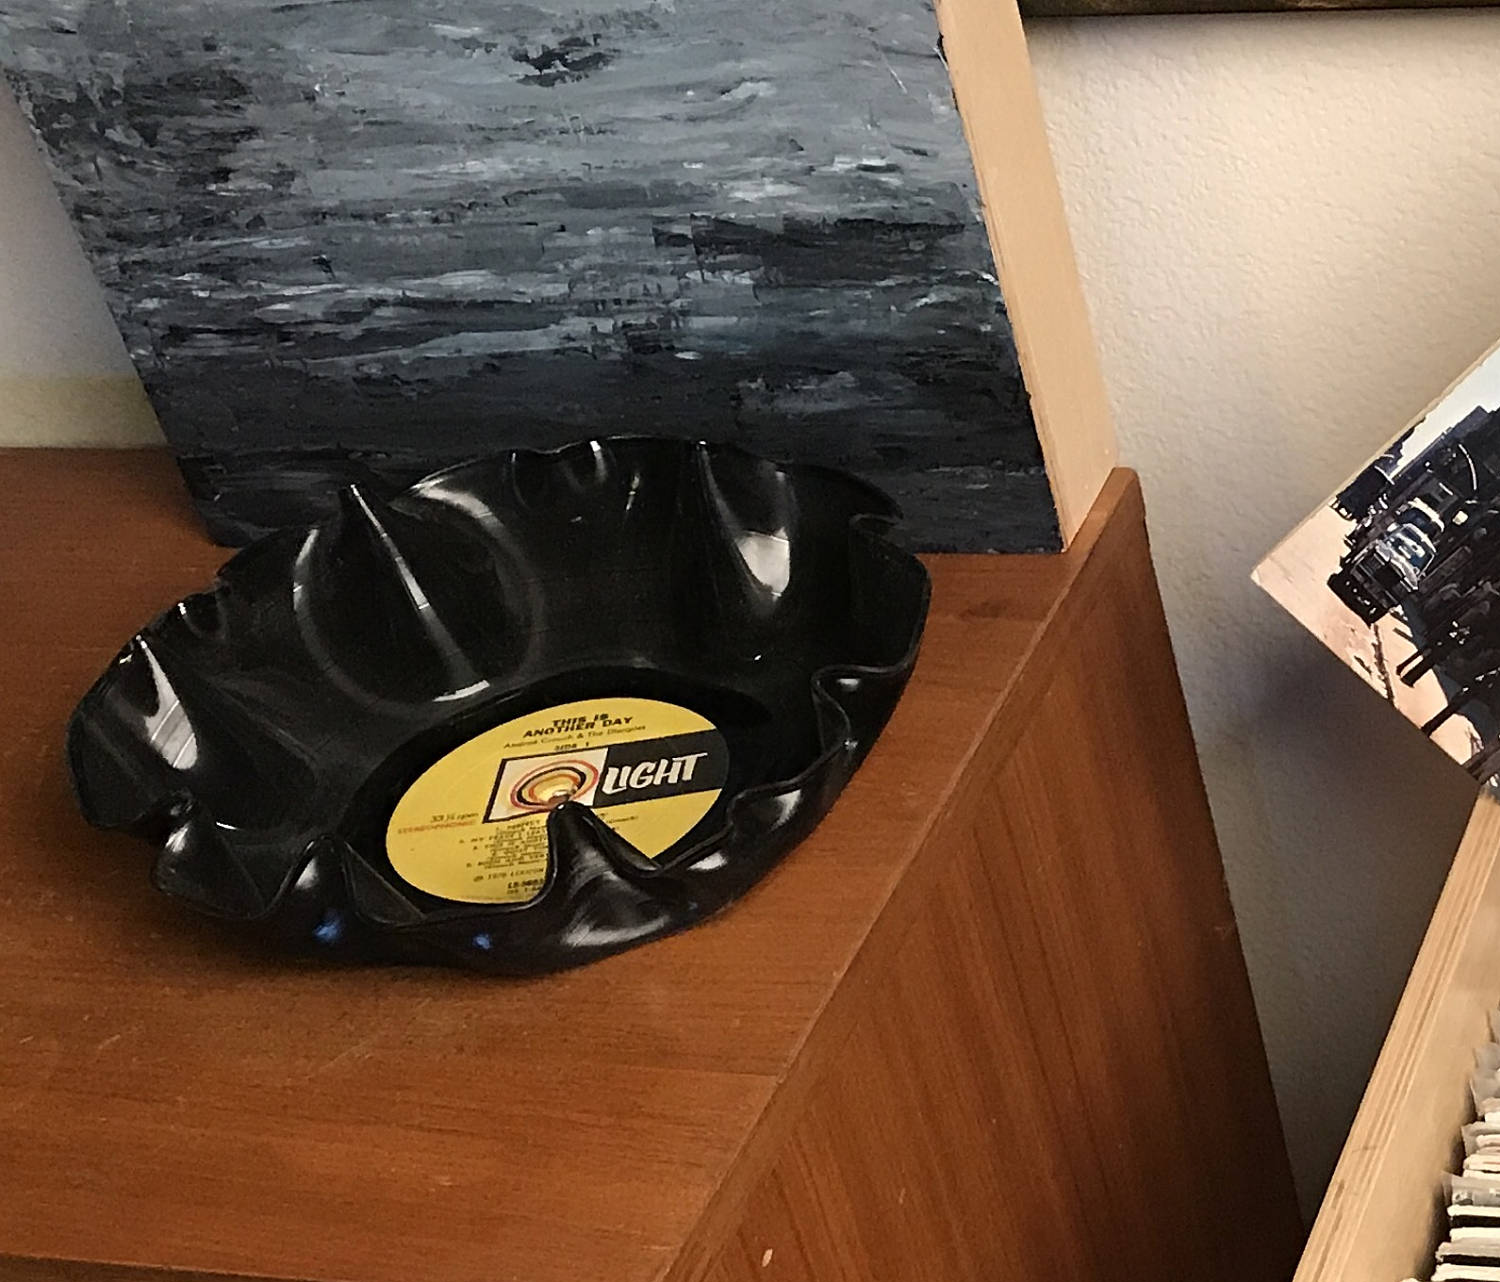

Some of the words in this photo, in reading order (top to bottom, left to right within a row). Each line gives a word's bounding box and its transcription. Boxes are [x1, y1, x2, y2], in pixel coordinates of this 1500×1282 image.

[523, 721, 596, 738] ANOTHER
[602, 716, 633, 727] DAY
[552, 716, 587, 728] THIS
[594, 713, 609, 721] IS
[602, 752, 708, 795] LIGHT
